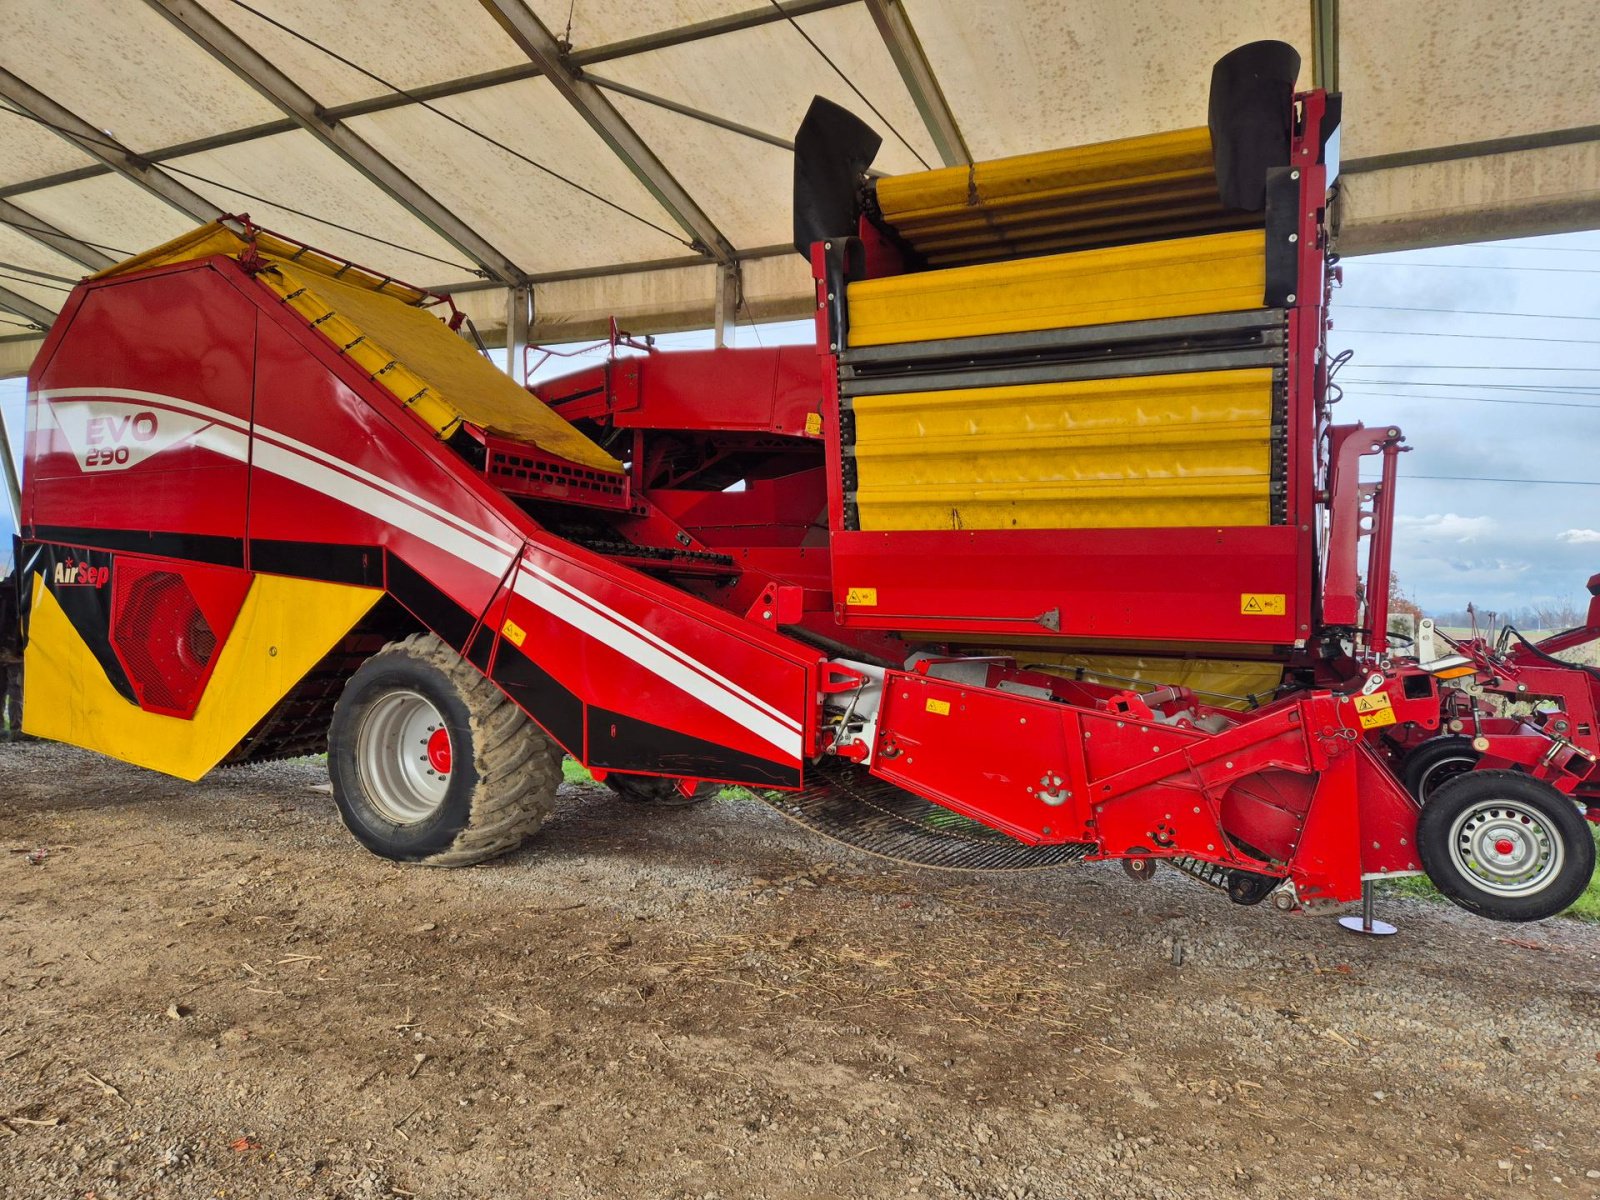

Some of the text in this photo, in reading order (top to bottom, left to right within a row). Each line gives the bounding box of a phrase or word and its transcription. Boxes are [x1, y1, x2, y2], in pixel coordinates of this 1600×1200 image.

[86, 411, 158, 445] EVO
[85, 446, 129, 467] 290
[54, 558, 109, 589] AirSep
